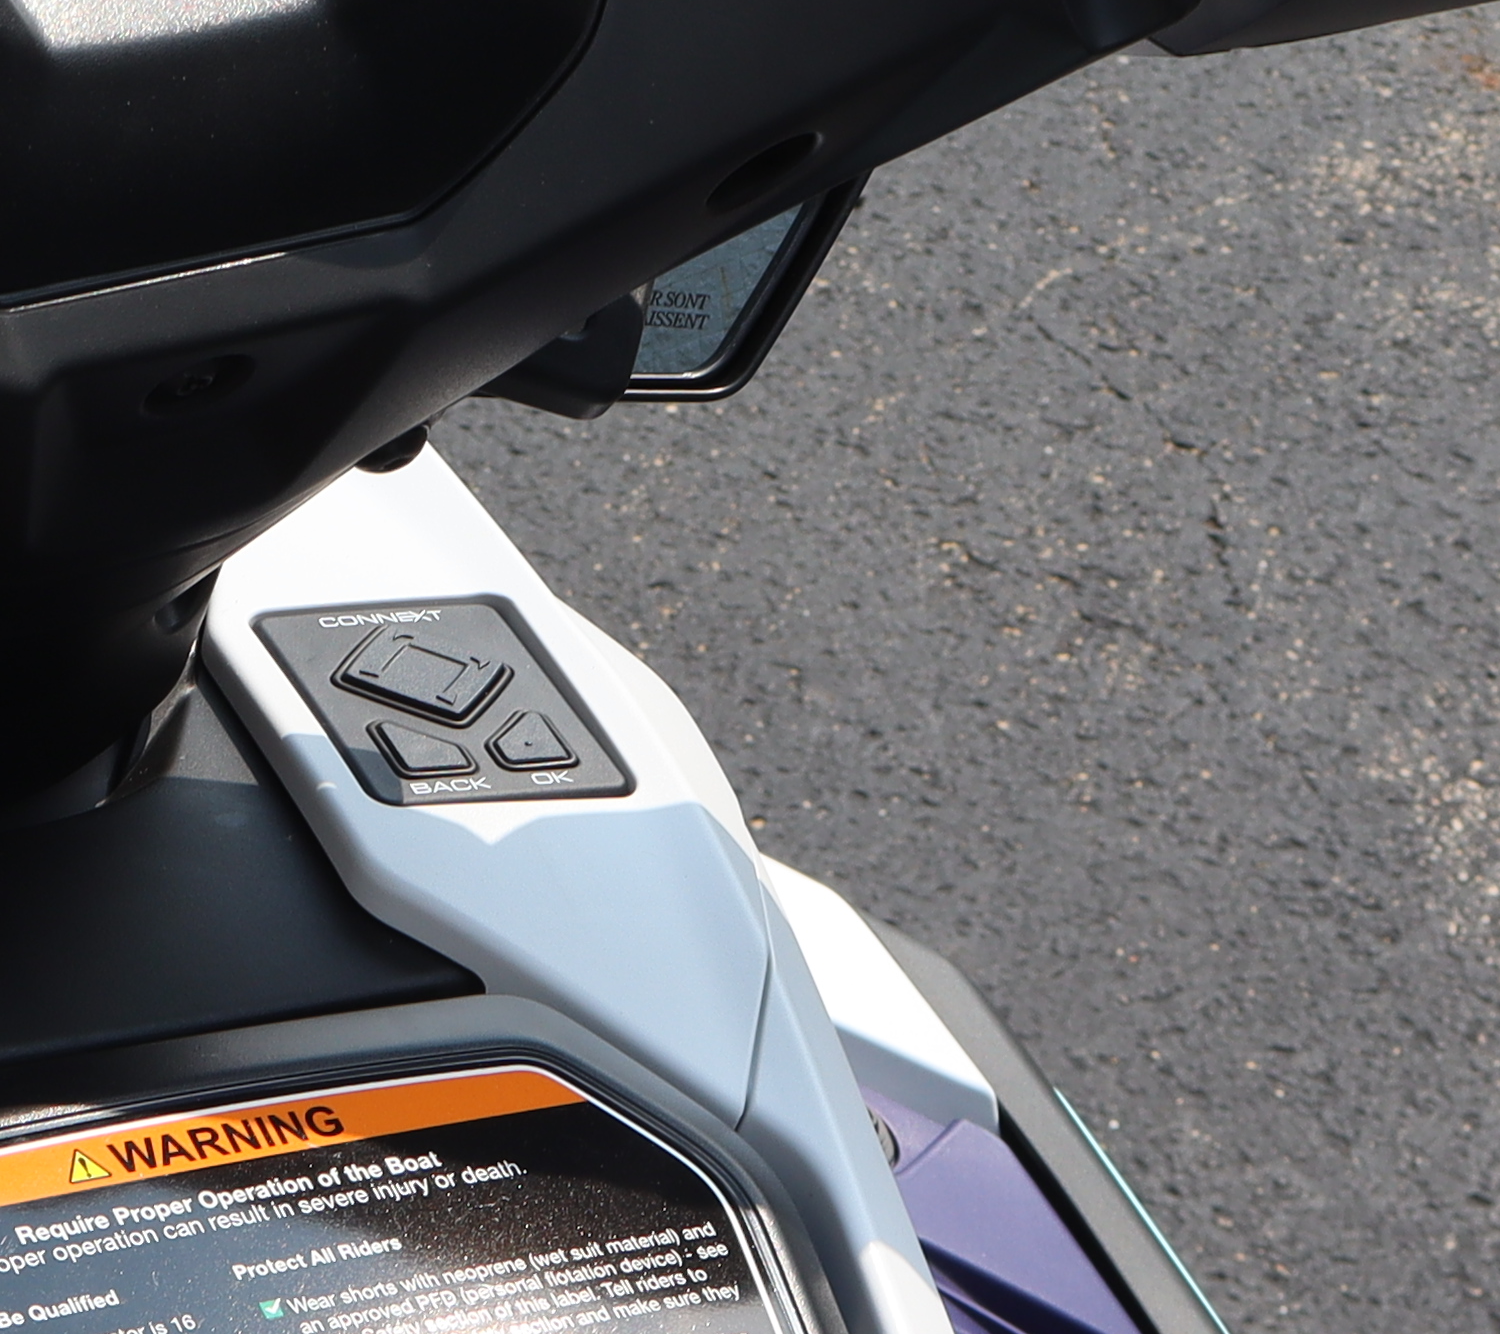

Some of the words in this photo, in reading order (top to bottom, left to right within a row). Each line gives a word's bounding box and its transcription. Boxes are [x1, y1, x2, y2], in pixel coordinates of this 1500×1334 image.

[664, 292, 711, 311] SONT
[645, 311, 711, 330] ISSENT
[318, 608, 442, 630] CONNEXT
[409, 776, 492, 795] BACK
[531, 769, 574, 786] OK
[107, 1105, 345, 1174] WARNING
[13, 1213, 111, 1246] Require
[111, 1196, 193, 1227] Proper
[196, 1175, 315, 1211] Operation
[316, 1165, 342, 1188] of
[342, 1162, 384, 1183] the
[383, 1150, 444, 1176] Boat
[51, 1228, 160, 1264] operation
[162, 1219, 206, 1241] can
[206, 1203, 272, 1232] result
[269, 1199, 296, 1220] in
[296, 1188, 370, 1215] severe
[369, 1176, 430, 1203] injury
[430, 1171, 457, 1190] or
[460, 1159, 528, 1185] death.
[230, 1252, 309, 1282] Protect
[310, 1245, 338, 1268] All
[336, 1236, 404, 1262] Riders
[27, 1288, 121, 1322] Qualified
[169, 1313, 197, 1334] 16
